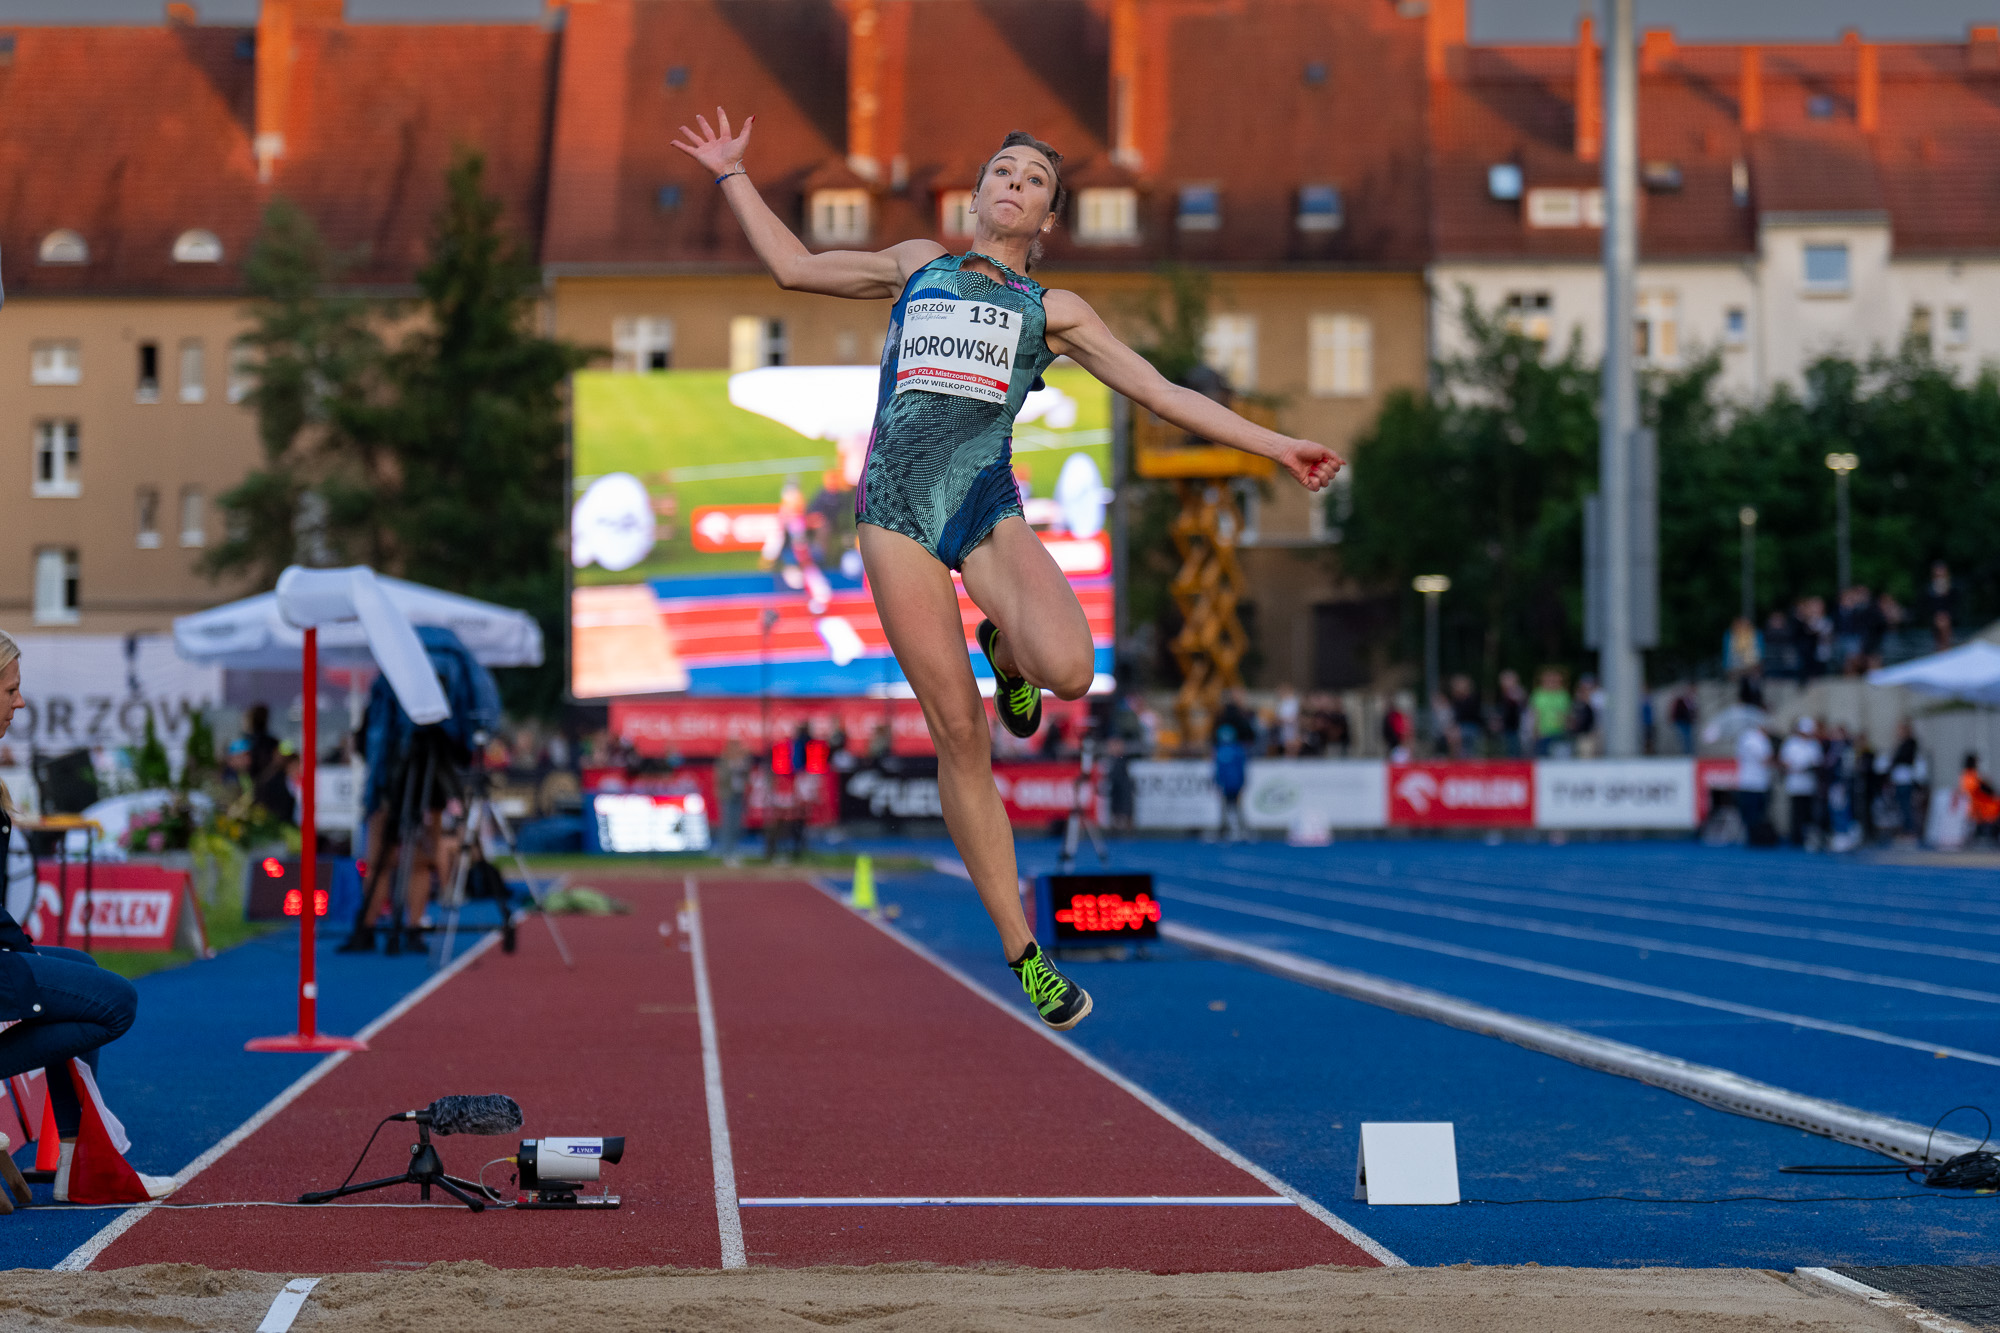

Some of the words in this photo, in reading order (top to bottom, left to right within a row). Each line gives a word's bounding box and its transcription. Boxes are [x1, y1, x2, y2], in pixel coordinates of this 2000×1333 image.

[907, 302, 956, 314] GORZÓW
[969, 305, 1010, 330] 131
[902, 335, 1010, 370] HOROWSKA
[917, 368, 934, 376] PZLA
[935, 369, 977, 382] Mistrzostwa
[978, 376, 998, 387] Polski
[930, 379, 987, 395] WIELKOPOLSKI
[1603, 781, 1677, 805] SPORT
[78, 900, 160, 928] ORLEN
